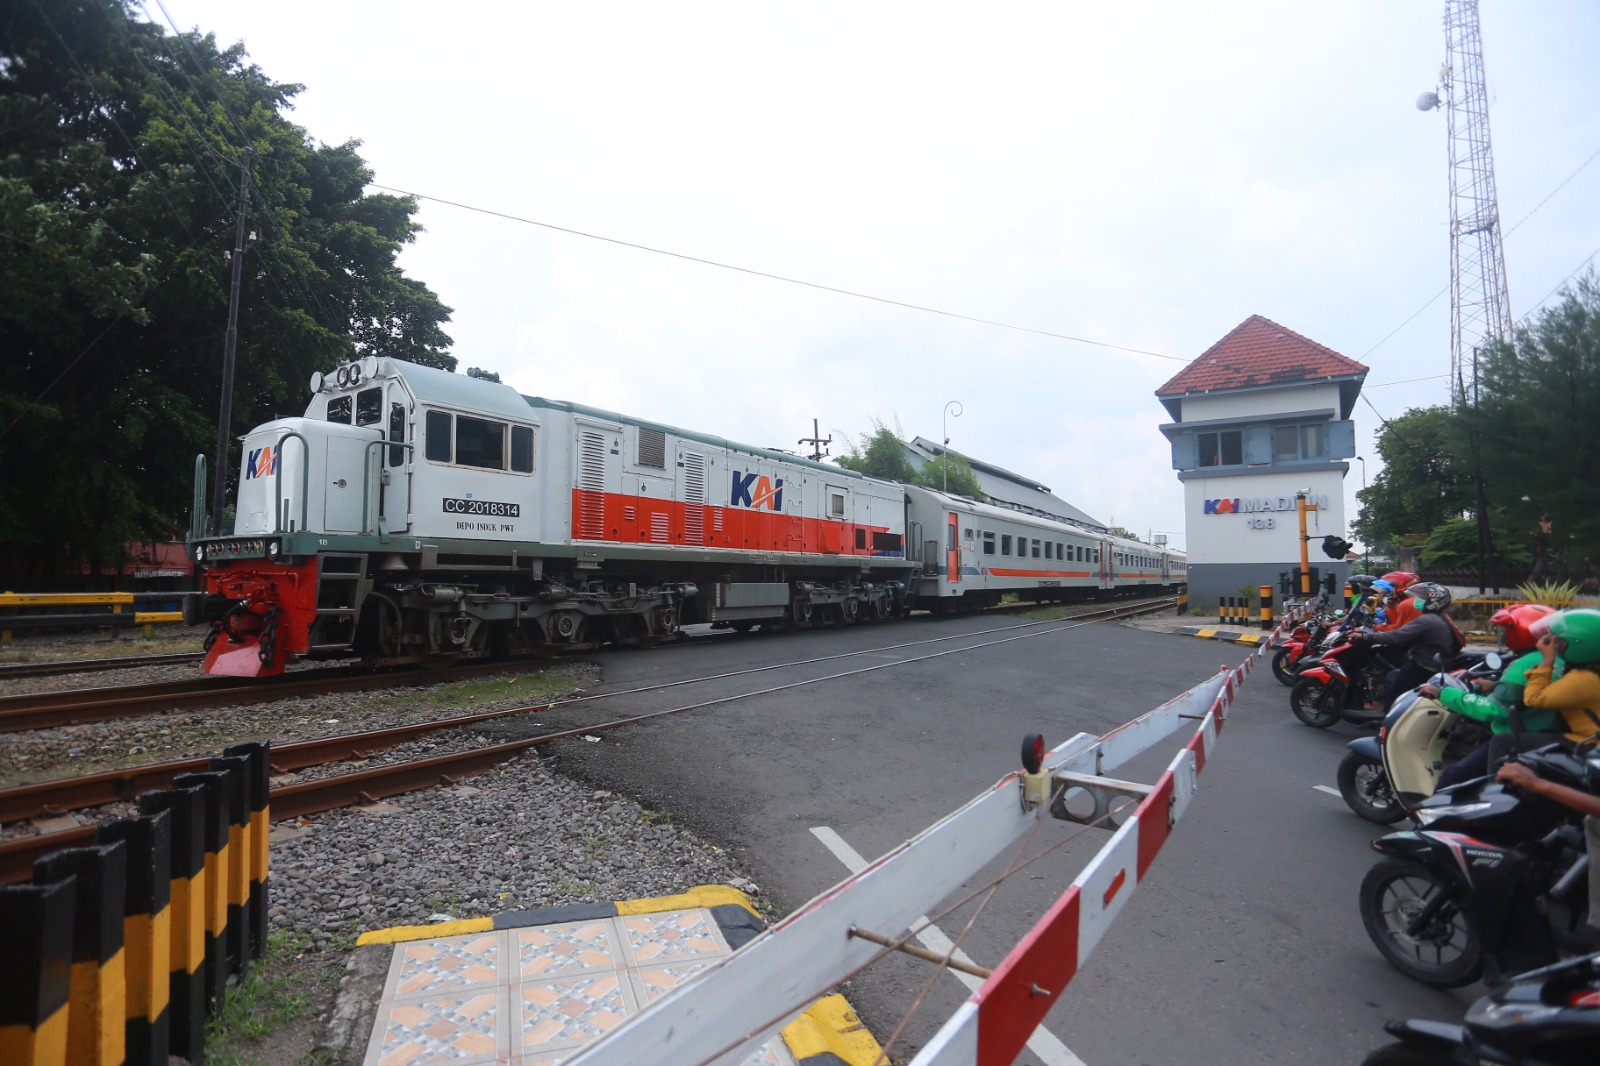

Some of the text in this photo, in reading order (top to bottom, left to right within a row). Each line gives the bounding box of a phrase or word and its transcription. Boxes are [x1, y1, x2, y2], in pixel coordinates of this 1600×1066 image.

[246, 445, 278, 480] KAI
[731, 470, 783, 511] KAI
[445, 499, 518, 516] CC 2018314
[1204, 498, 1240, 514] KAI
[456, 521, 475, 530] DEPO
[1248, 517, 1275, 530] 138
